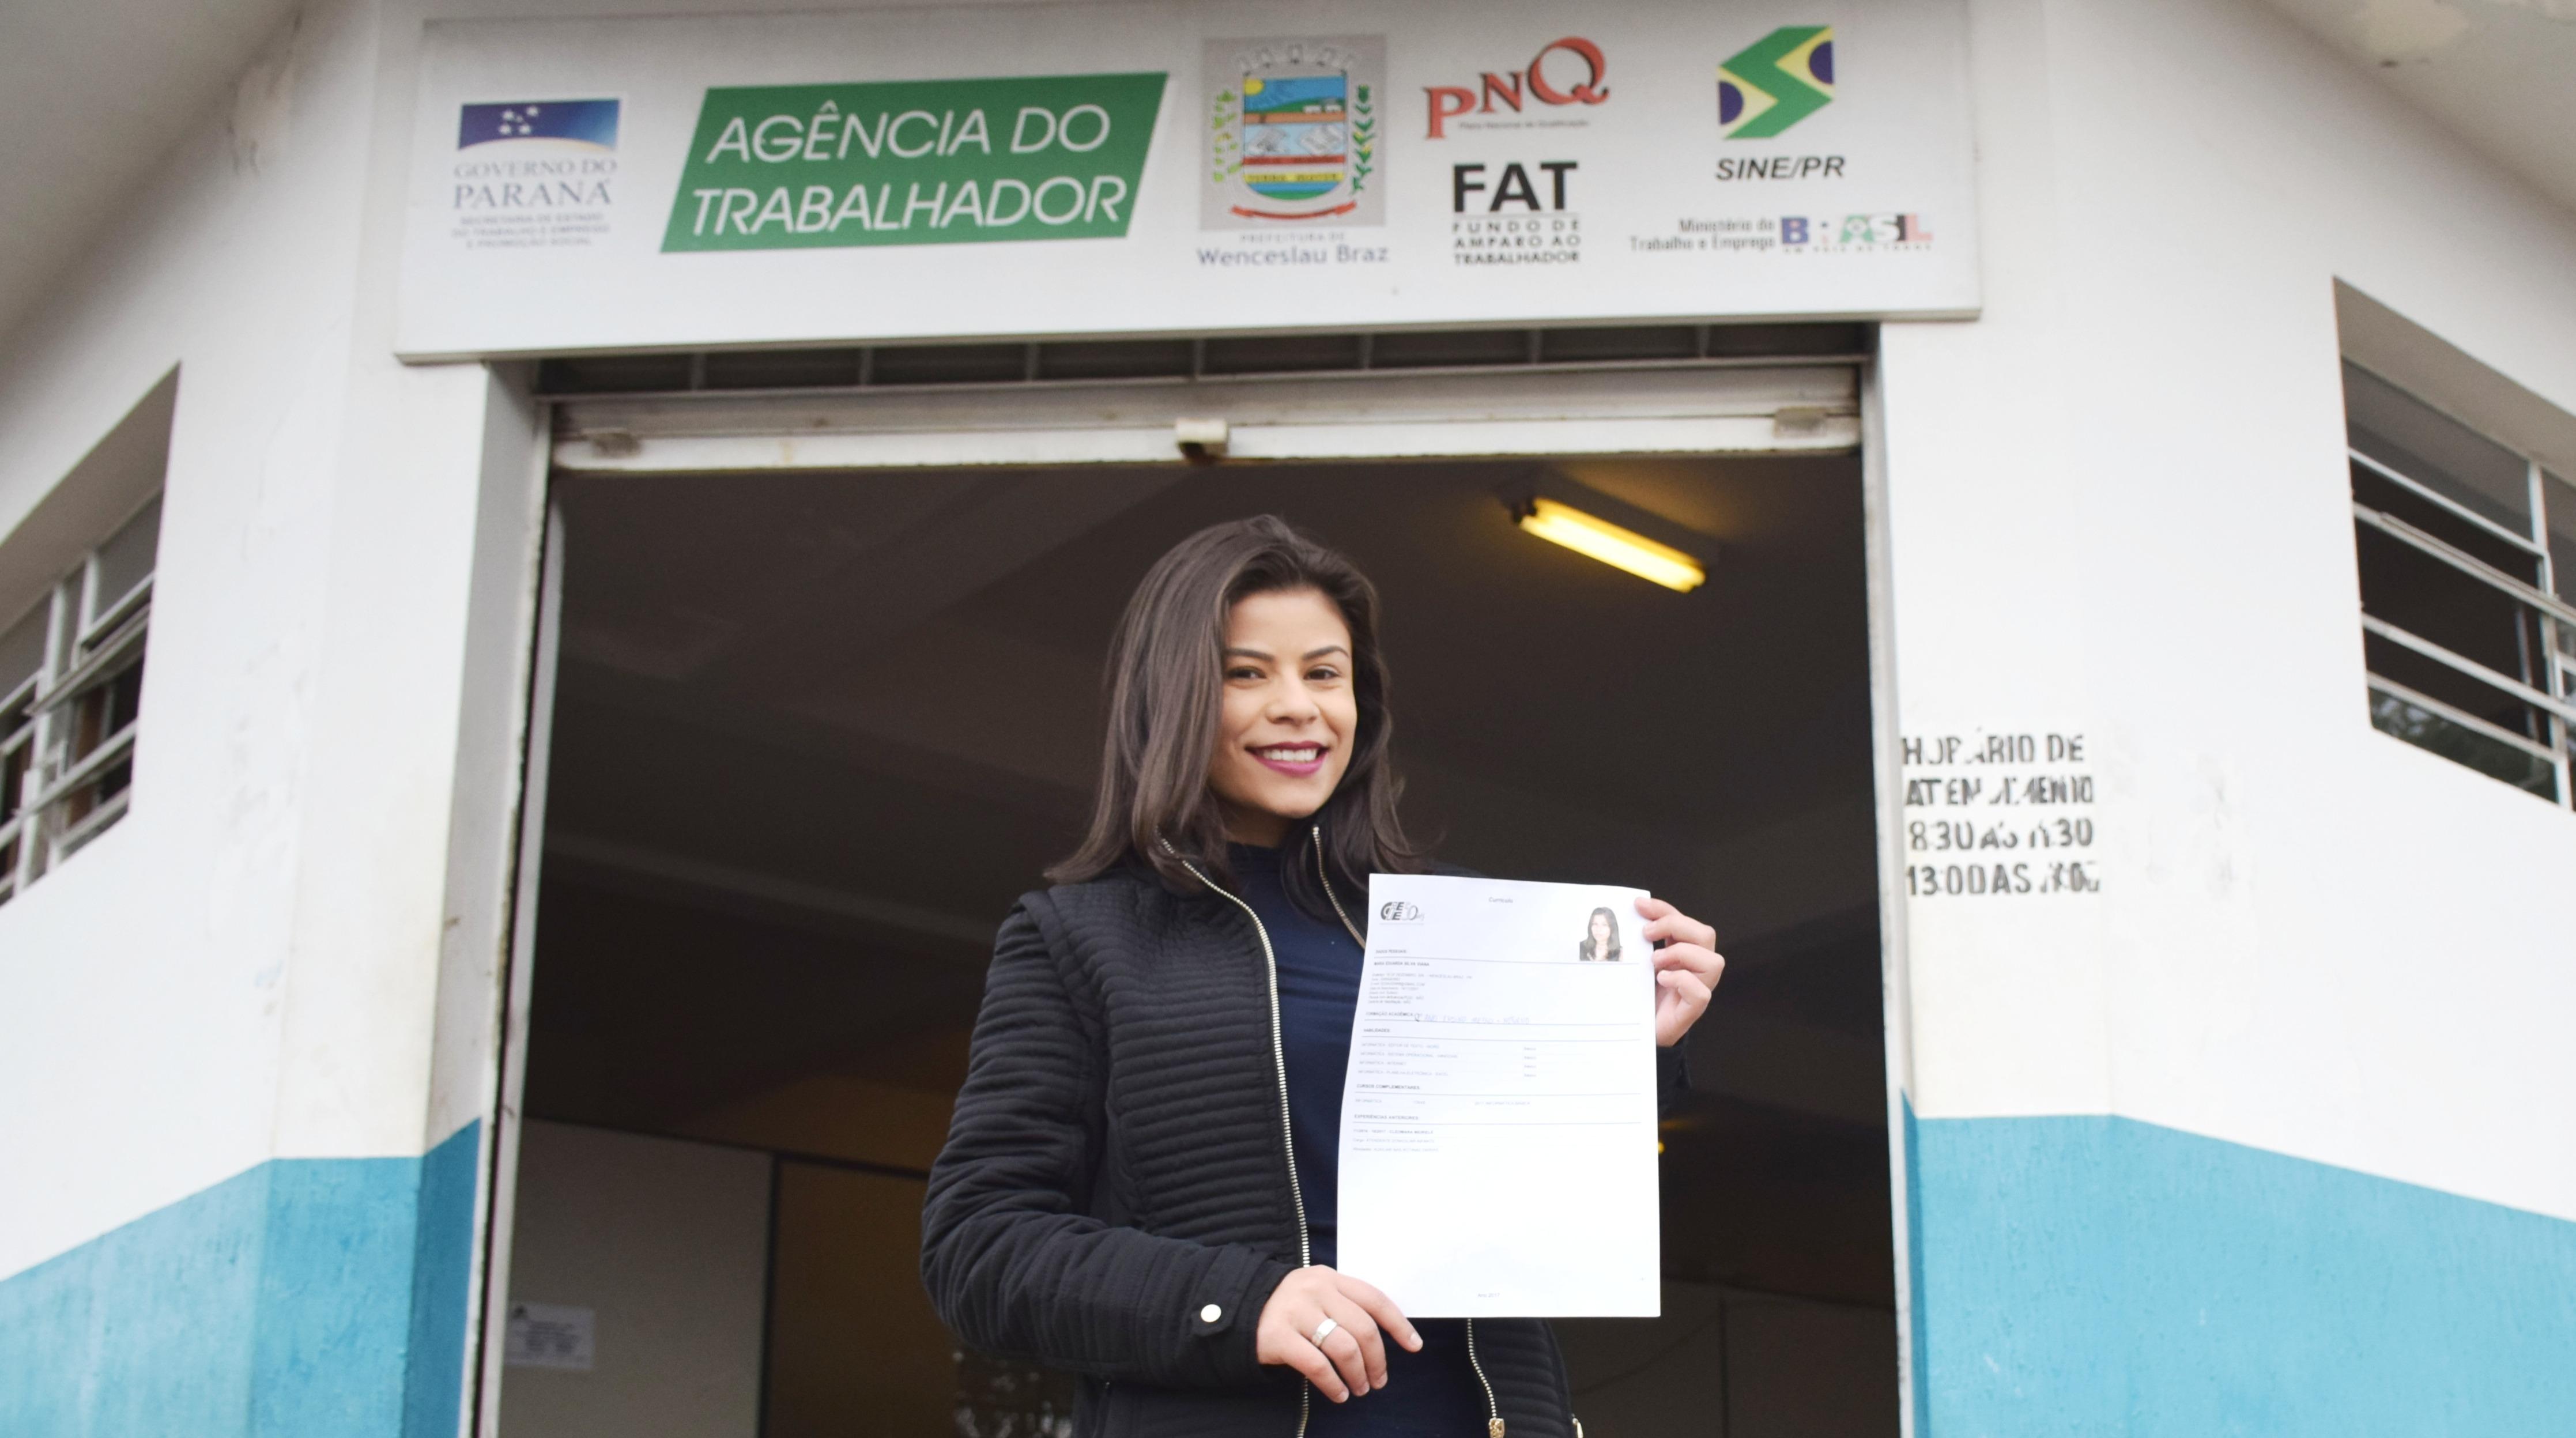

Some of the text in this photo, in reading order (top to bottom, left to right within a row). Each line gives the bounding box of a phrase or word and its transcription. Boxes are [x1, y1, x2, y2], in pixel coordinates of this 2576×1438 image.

[1422, 36, 1610, 140] PNQ
[705, 99, 1111, 164] AGÊNCIA DO
[454, 158, 618, 179] GOVERNO DO
[1715, 156, 1846, 181] SINE/PR
[454, 177, 612, 209] PARANÁ
[1453, 160, 1579, 213] FAT
[692, 175, 1127, 236] TRABALHADOR
[1453, 219, 1580, 233] FUNDO DE
[1454, 233, 1581, 249] AMPARO AO
[1781, 213, 1933, 244] BASIL
[1197, 244, 1389, 266] Wenceslau Braz
[1454, 251, 1581, 265] TRABALHADOR
[2046, 733, 2085, 764] DE
[1992, 862, 2032, 895] AS
